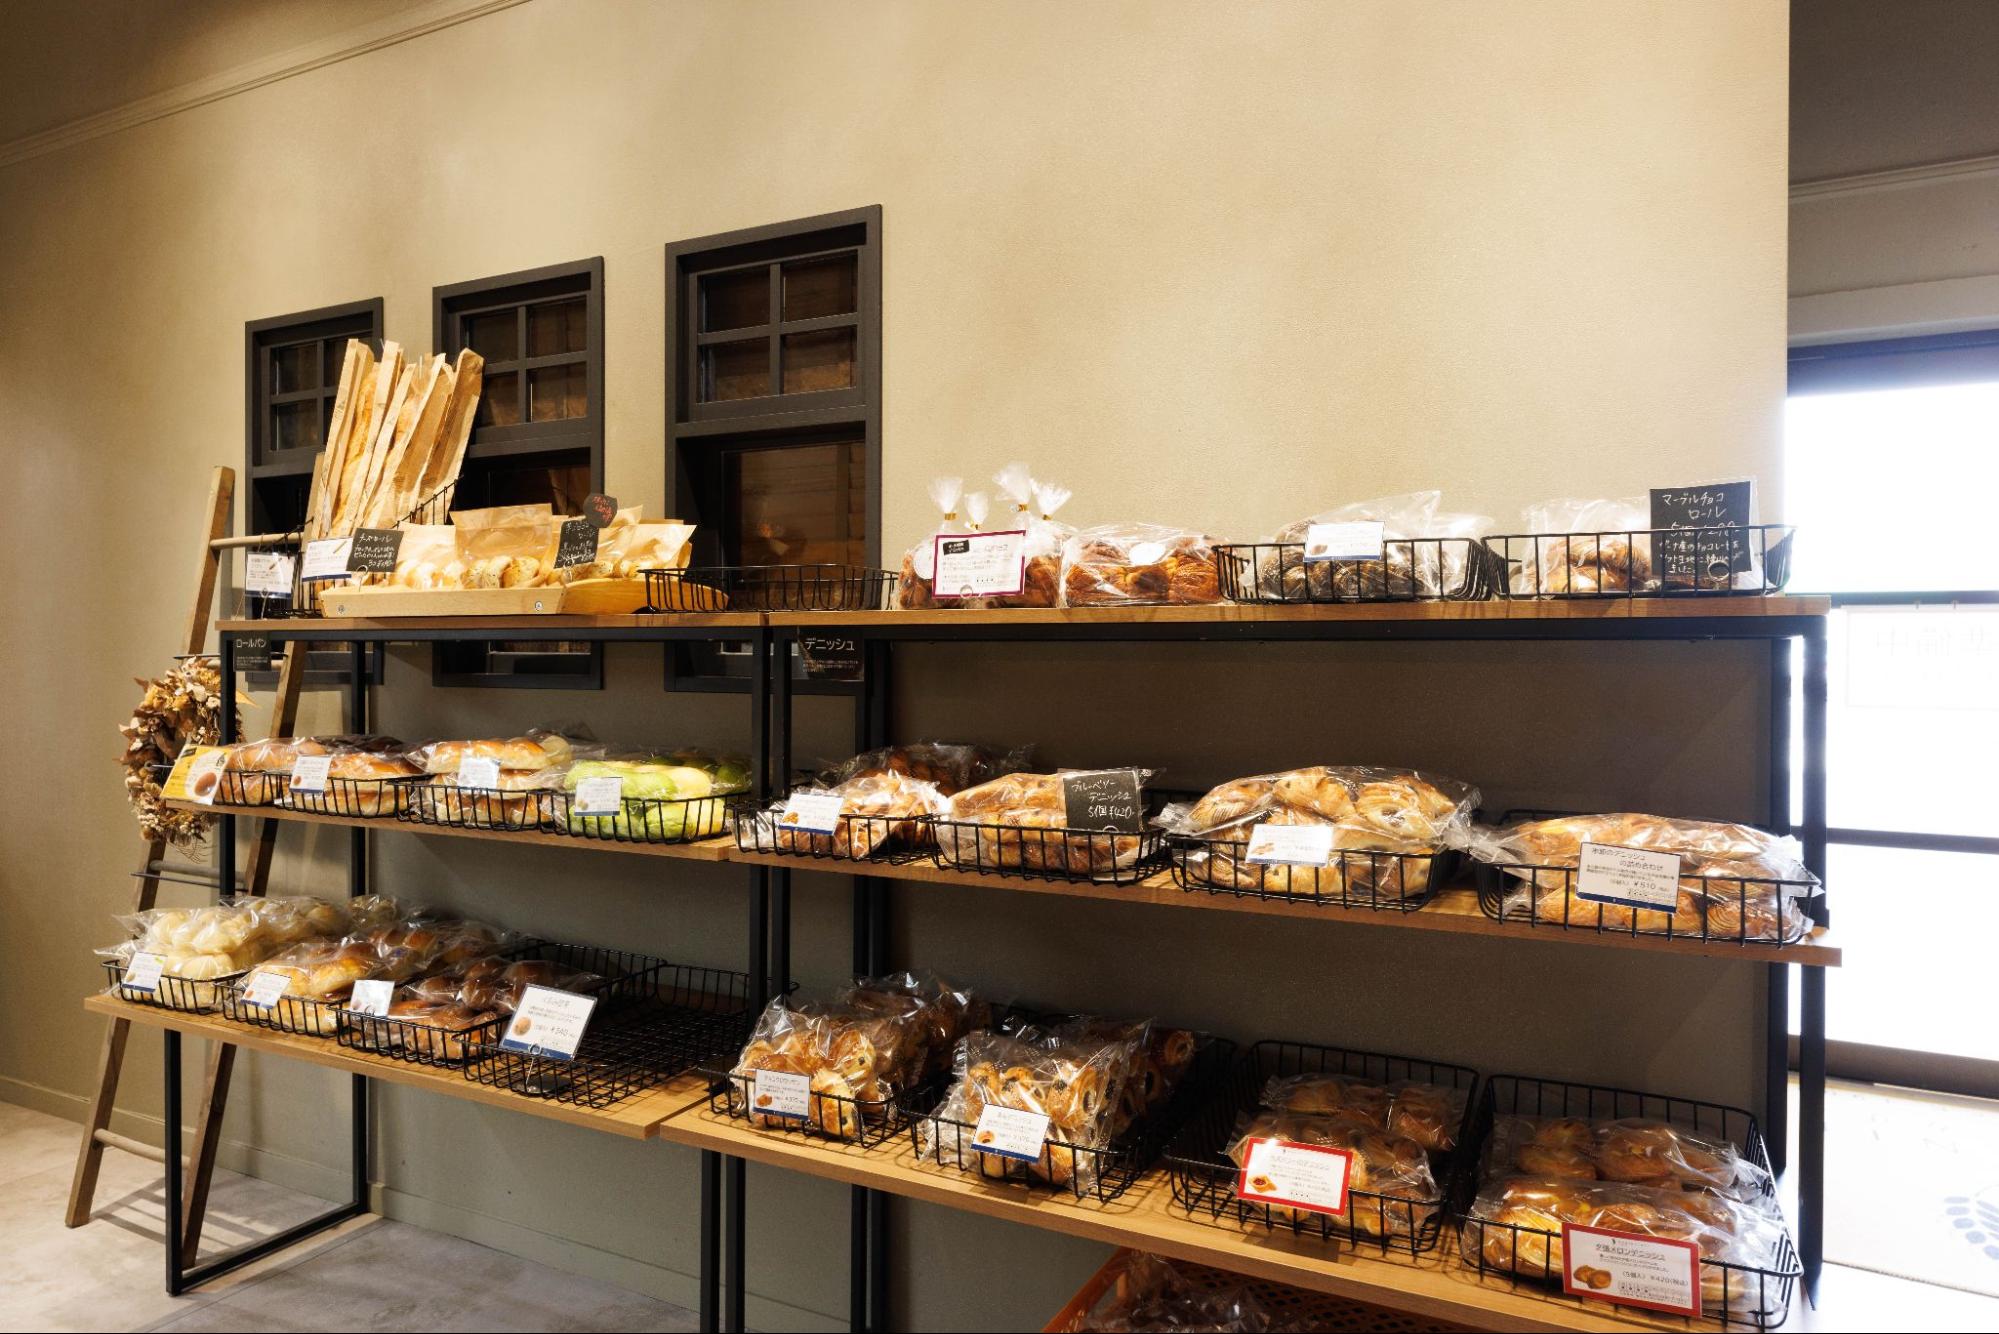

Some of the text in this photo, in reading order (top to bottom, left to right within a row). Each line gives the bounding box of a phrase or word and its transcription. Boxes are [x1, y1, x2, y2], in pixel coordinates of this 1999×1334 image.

[1662, 491, 1724, 506] マーブルチョコ
[1688, 505, 1727, 520] ロール
[236, 638, 267, 648] ロールパン
[804, 636, 855, 651] デニッシュ
[1071, 779, 1116, 793] ブルーベリー
[1088, 791, 1132, 803] デニッシュ
